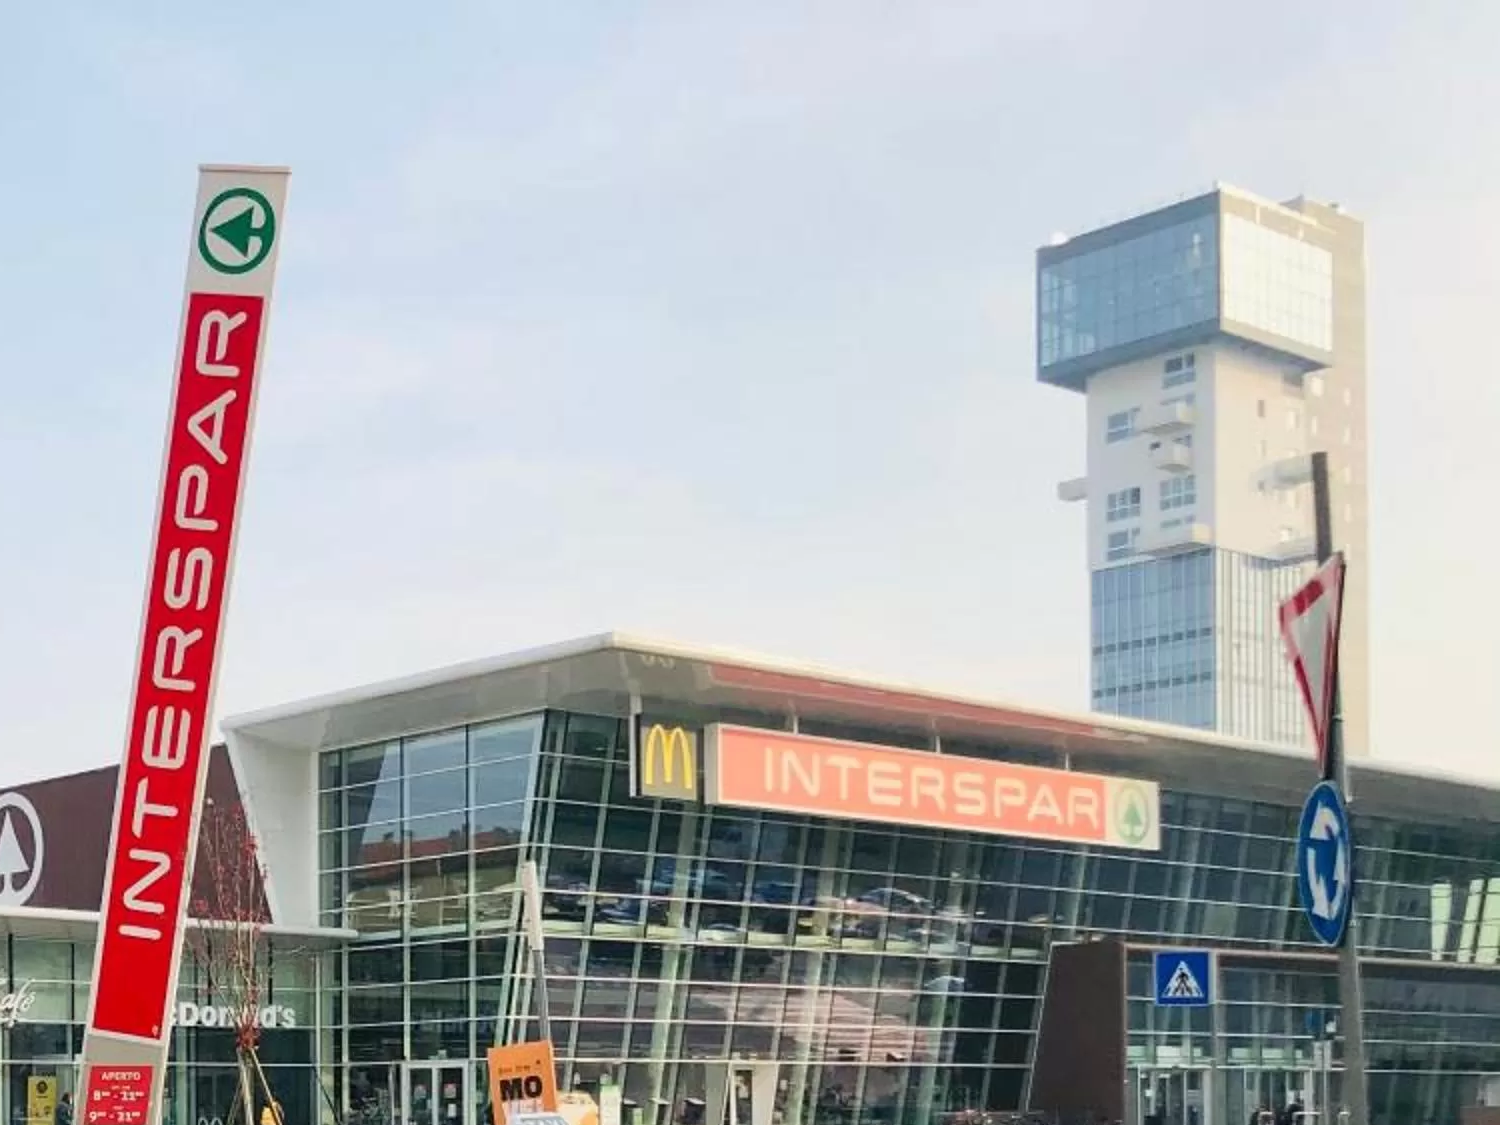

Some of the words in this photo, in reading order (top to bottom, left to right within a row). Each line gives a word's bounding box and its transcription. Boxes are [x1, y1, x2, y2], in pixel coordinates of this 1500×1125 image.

[118, 308, 247, 940] INTERSPAR
[764, 746, 1100, 830] INTERSPAR
[101, 1072, 141, 1081] APERTO
